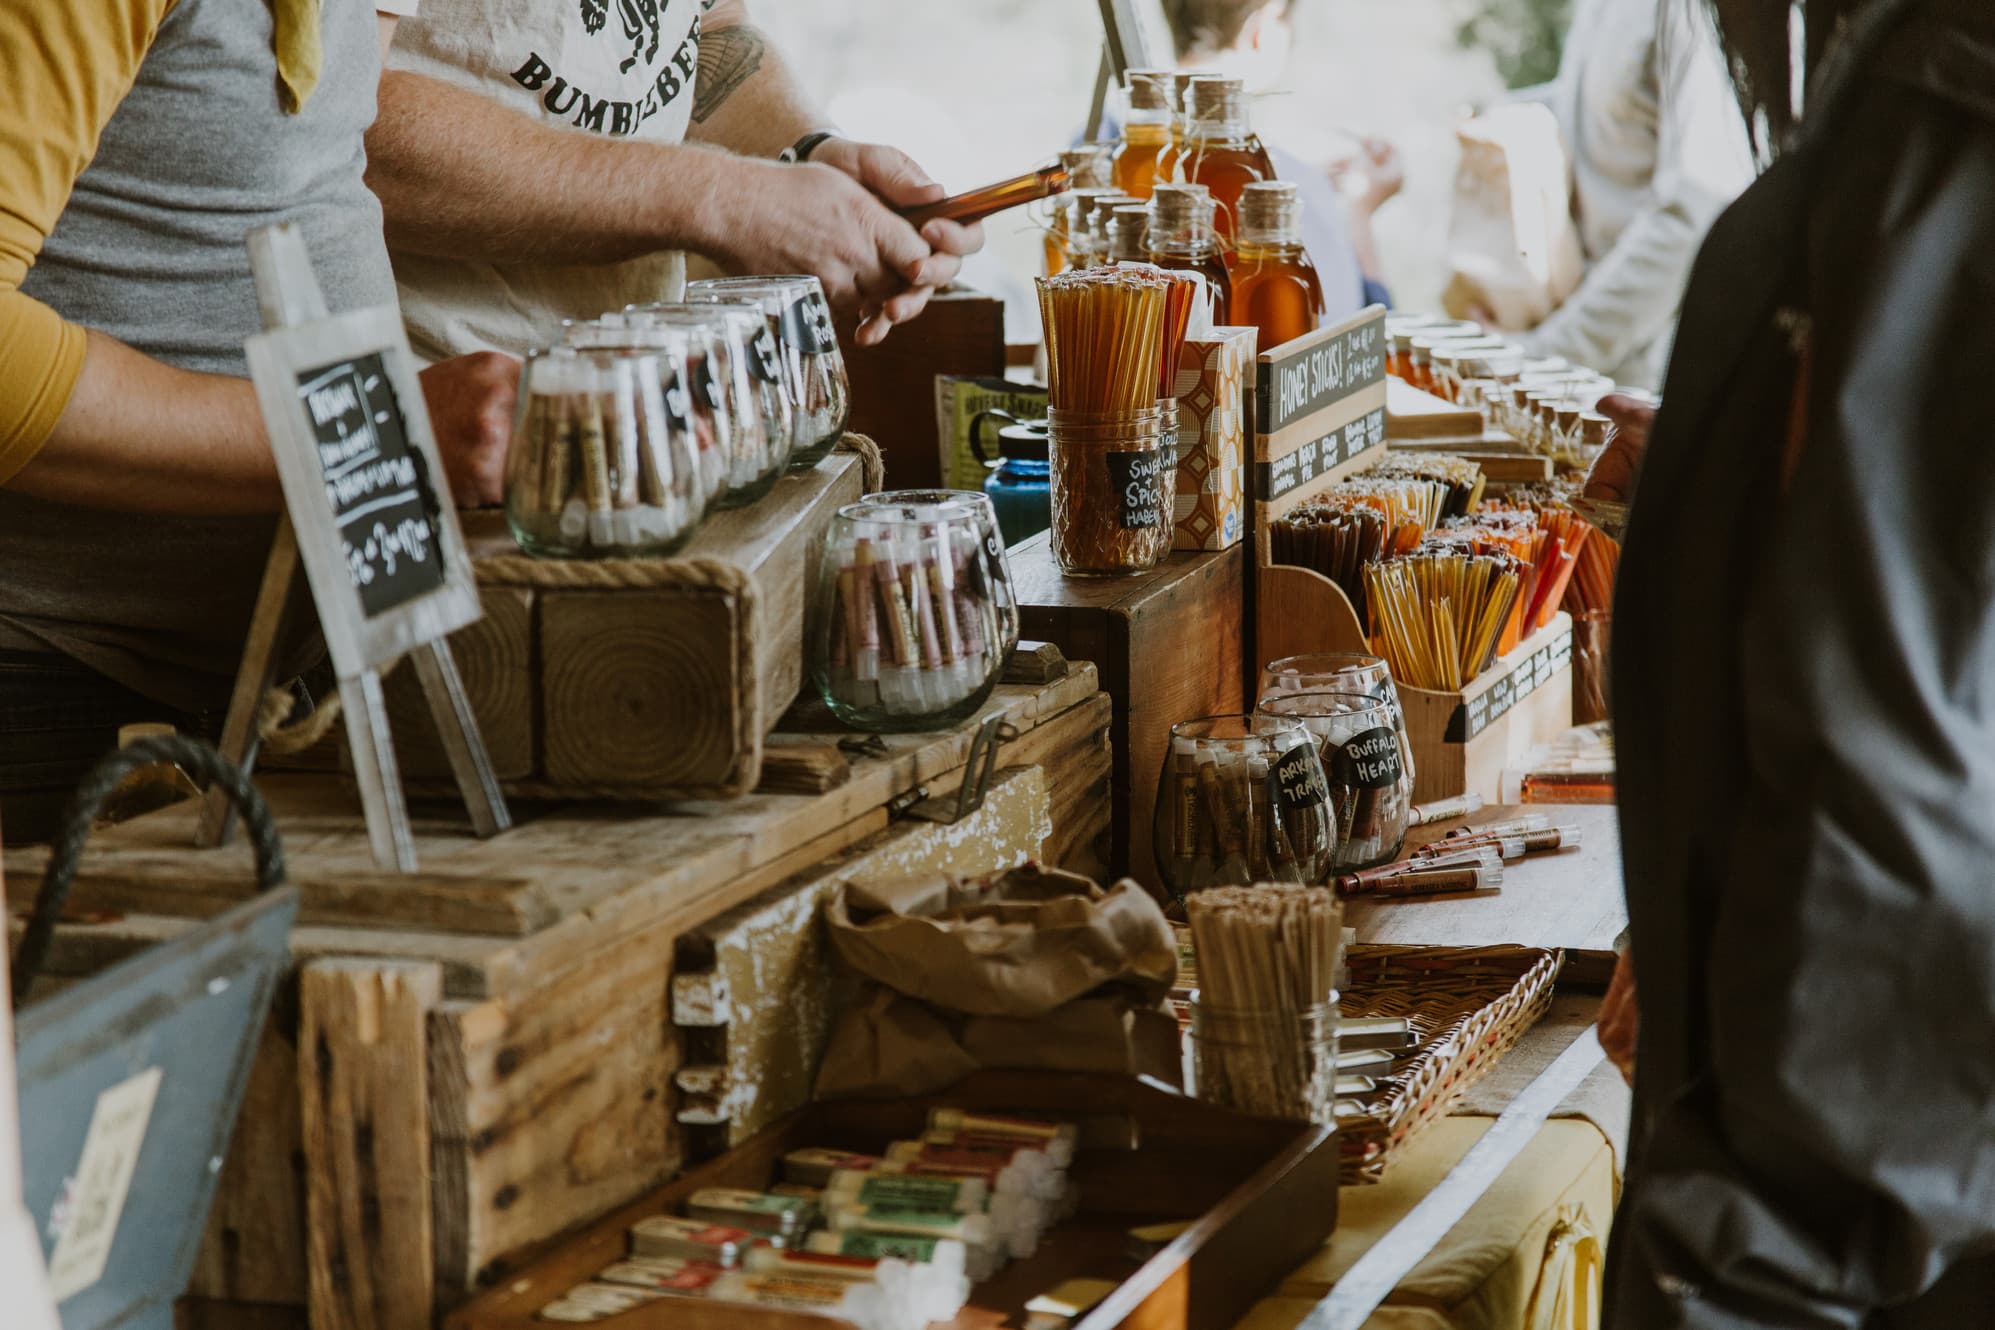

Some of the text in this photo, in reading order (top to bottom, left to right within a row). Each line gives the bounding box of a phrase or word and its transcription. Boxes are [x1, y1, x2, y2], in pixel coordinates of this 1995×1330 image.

[1280, 341, 1343, 424] HONEY STICKS!
[1356, 752, 1400, 783] HEART
